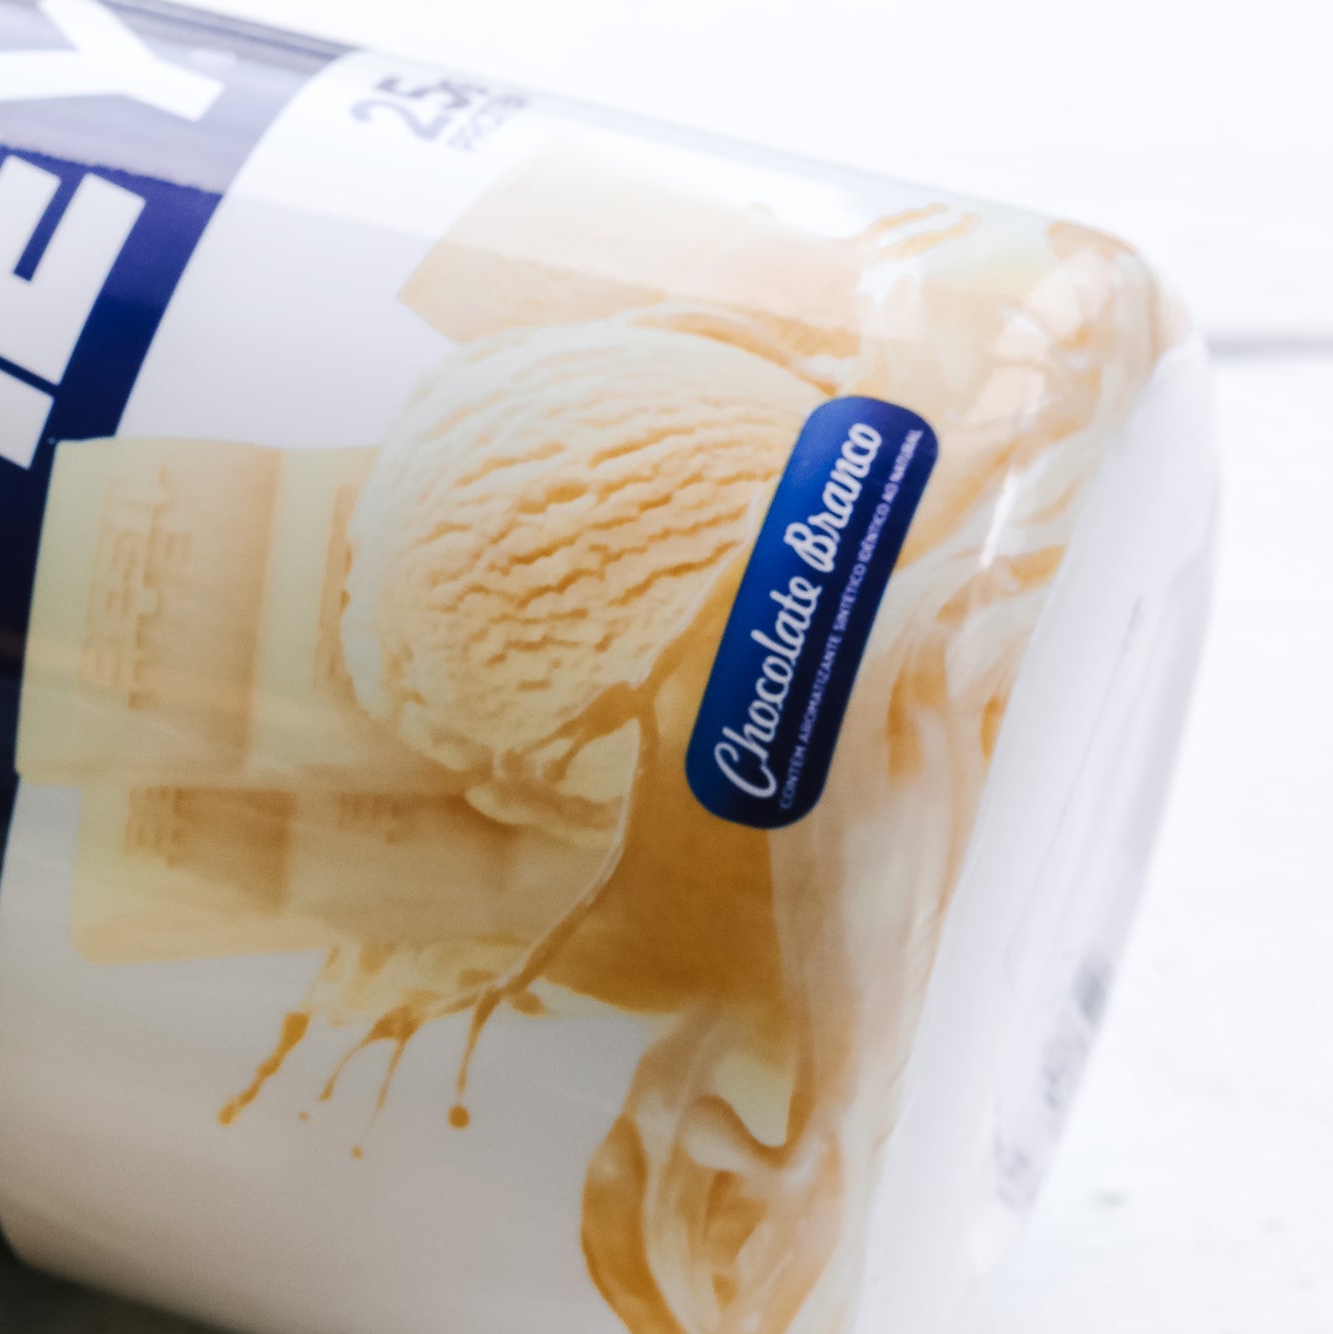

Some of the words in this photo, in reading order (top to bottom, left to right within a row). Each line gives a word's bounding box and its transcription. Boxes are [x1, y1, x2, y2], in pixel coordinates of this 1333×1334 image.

[713, 576, 823, 798] Chocolate
[783, 422, 882, 573] Branco
[797, 634, 842, 743] AROMATIZANTE
